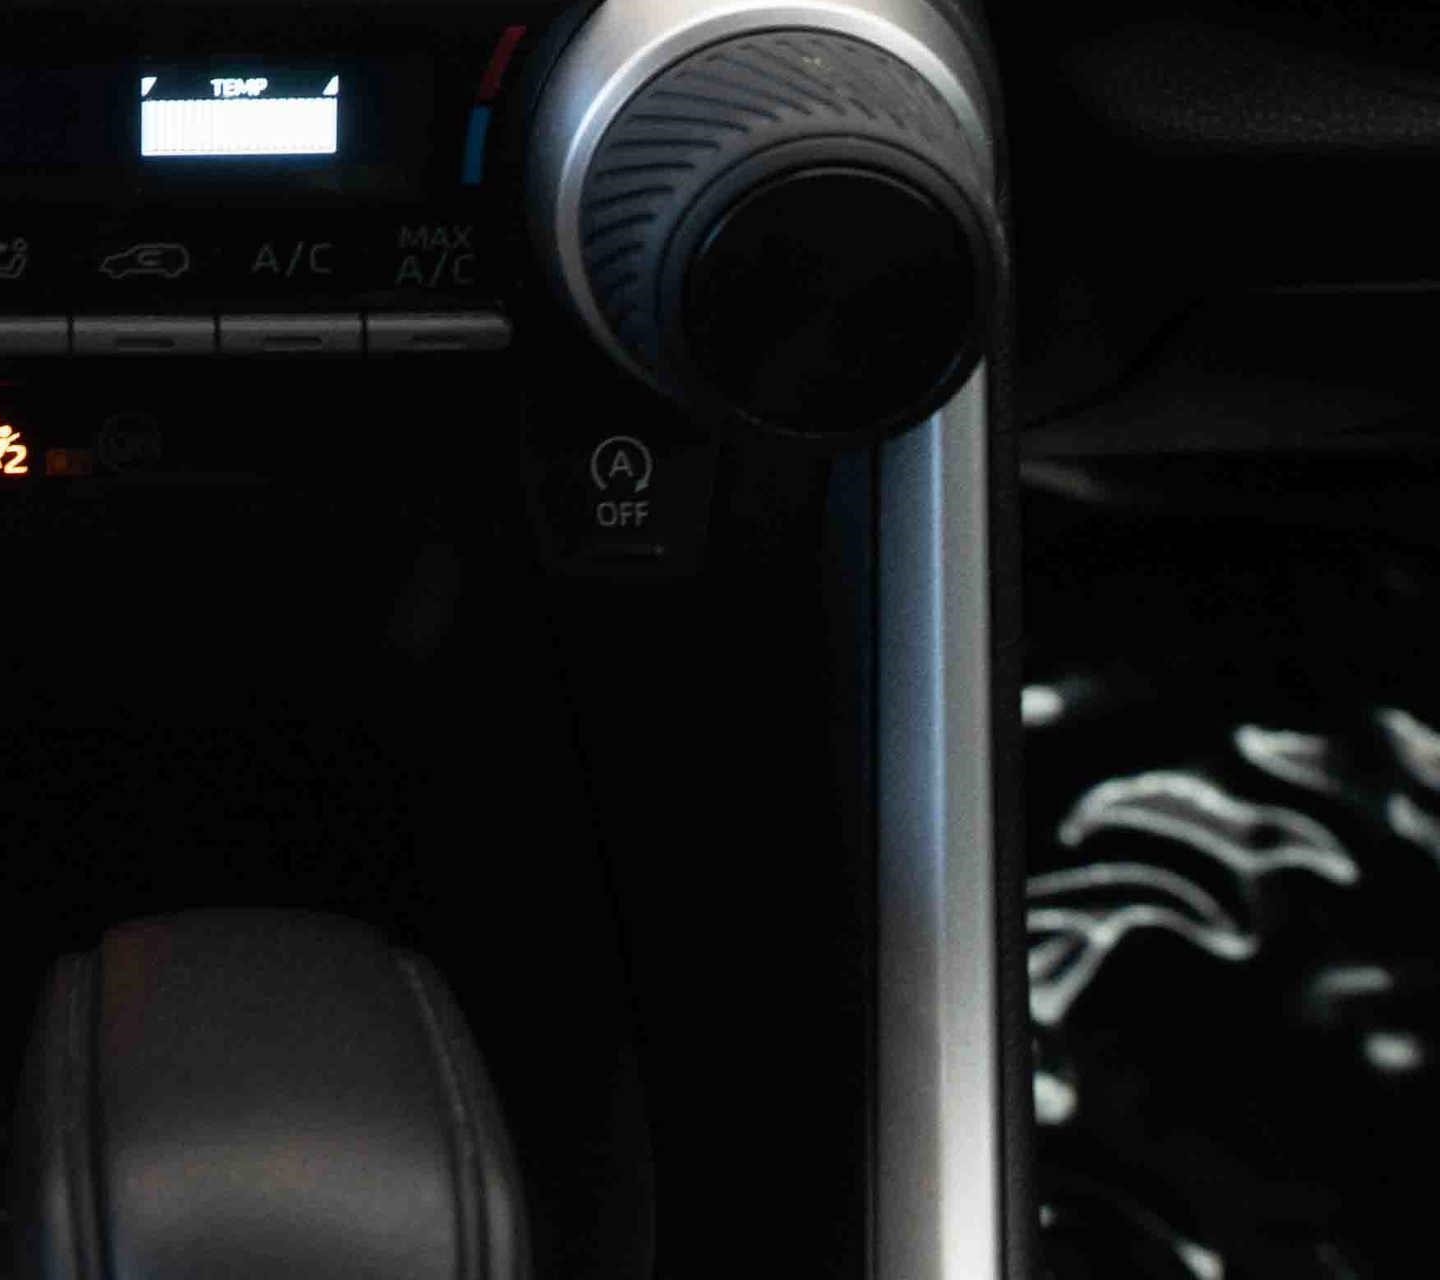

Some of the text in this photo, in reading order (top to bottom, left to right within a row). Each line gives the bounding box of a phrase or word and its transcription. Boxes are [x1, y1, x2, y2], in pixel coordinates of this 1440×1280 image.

[210, 77, 268, 97] TEMP
[398, 225, 472, 249] MAX
[251, 240, 333, 278] A/C
[394, 250, 475, 288] A/C
[596, 502, 649, 527] OFF
